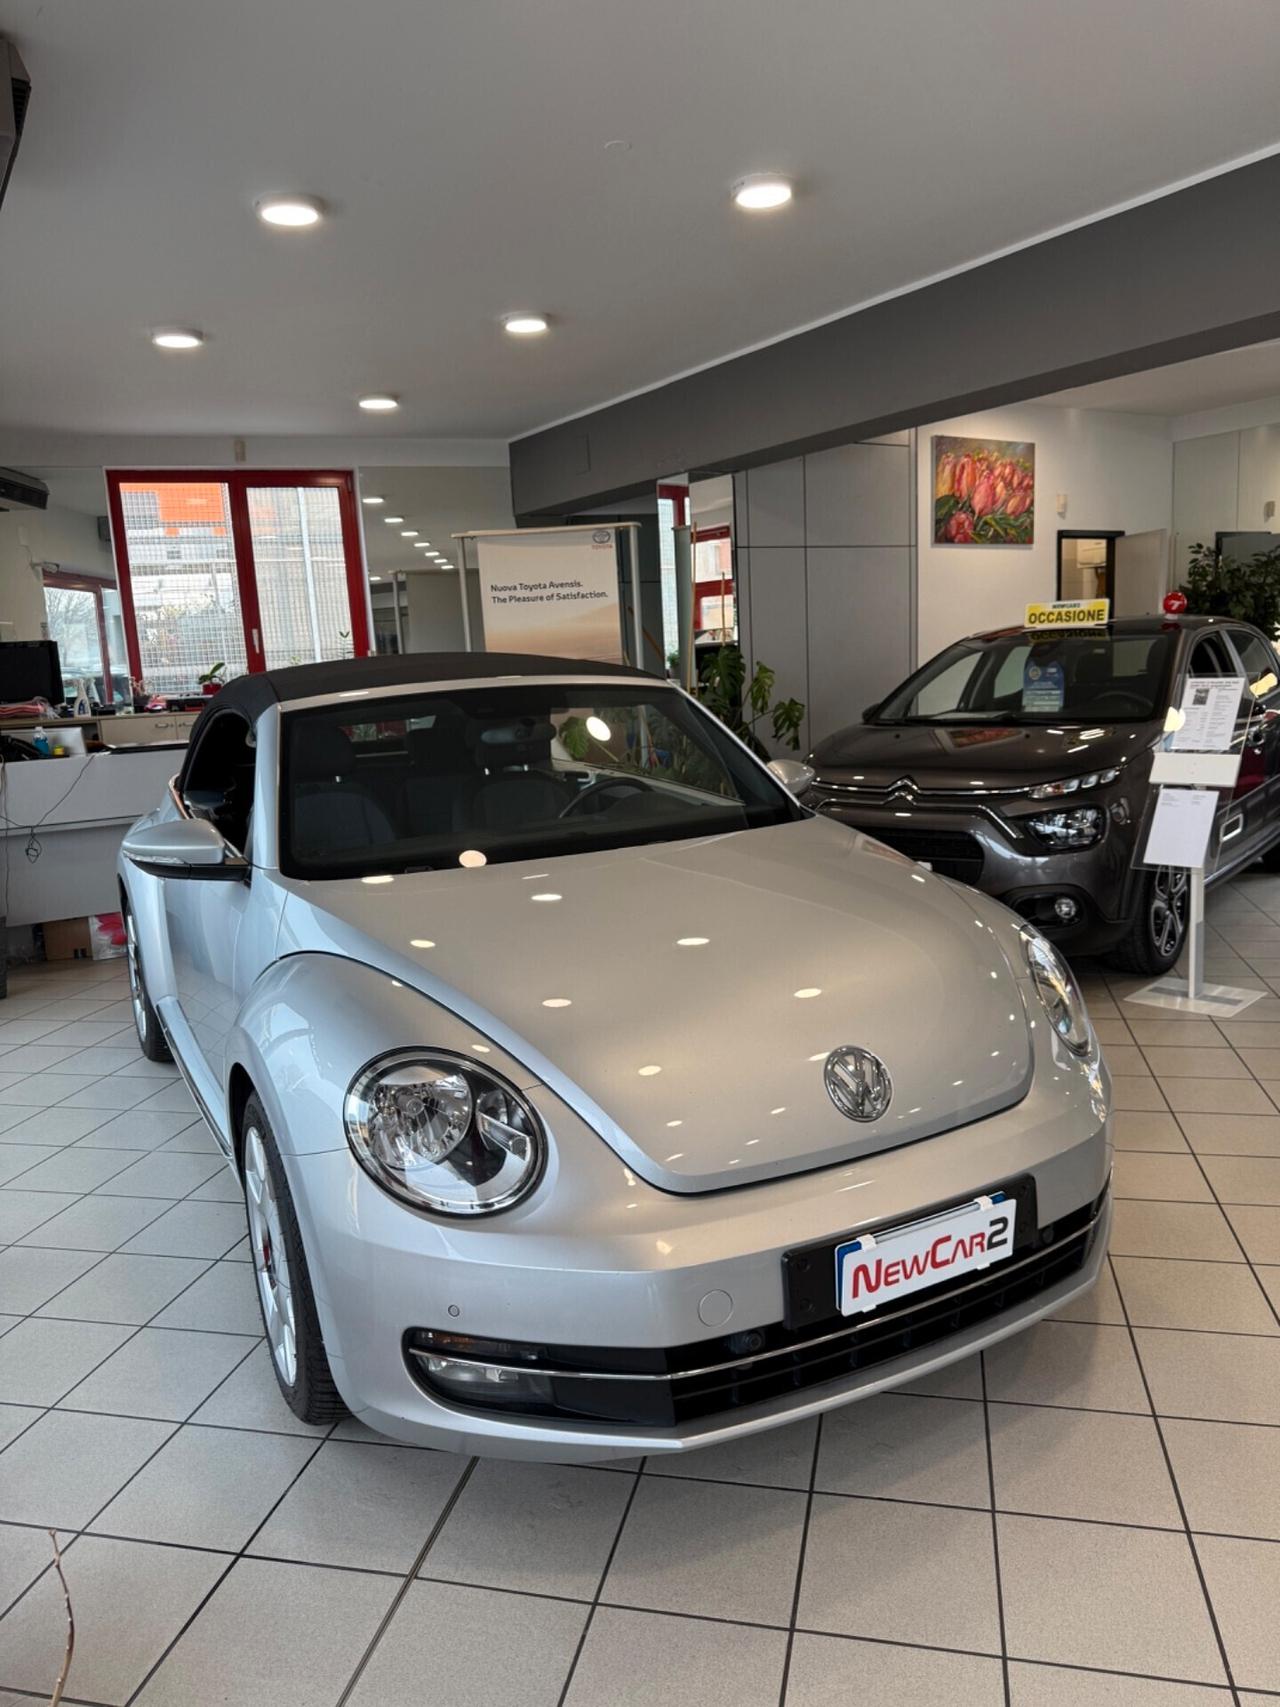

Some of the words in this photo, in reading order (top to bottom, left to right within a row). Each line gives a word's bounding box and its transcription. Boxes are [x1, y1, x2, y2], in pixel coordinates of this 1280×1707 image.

[491, 584, 517, 592] Nuova
[519, 582, 547, 592] Toyota
[549, 580, 583, 589] Avensis.
[492, 596, 507, 604] The
[509, 594, 544, 602] Pleasure
[546, 592, 555, 601] of
[556, 590, 609, 601] Satisfaction.
[1028, 609, 1105, 624] OCCASIONE
